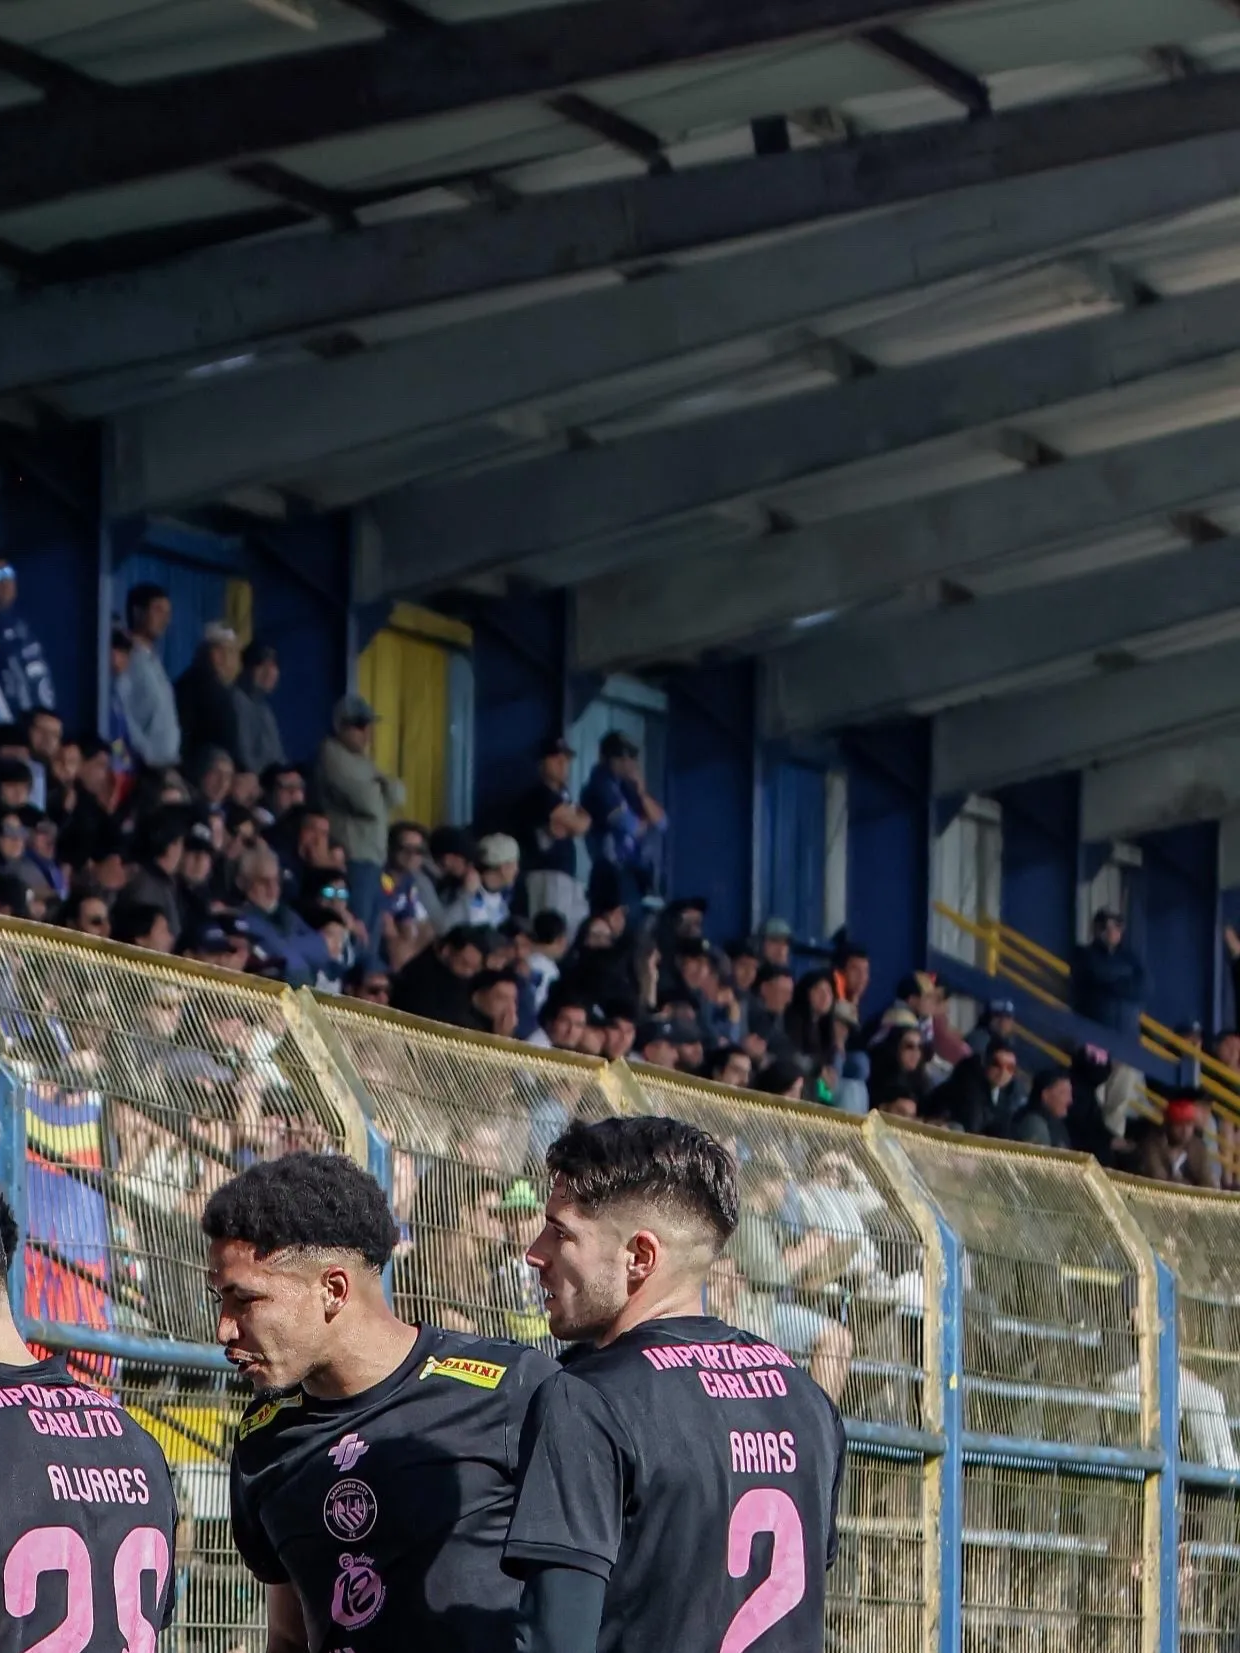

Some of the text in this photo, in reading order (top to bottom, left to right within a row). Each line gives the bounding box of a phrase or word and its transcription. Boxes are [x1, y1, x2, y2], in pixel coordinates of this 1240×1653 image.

[441, 1359, 500, 1379] PANINI
[642, 1344, 796, 1371] IMPORTADORA
[699, 1369, 787, 1399] CARLITO
[27, 1409, 123, 1438] CARLITO
[729, 1431, 797, 1473] ARIAS
[47, 1464, 150, 1505] ALVARES
